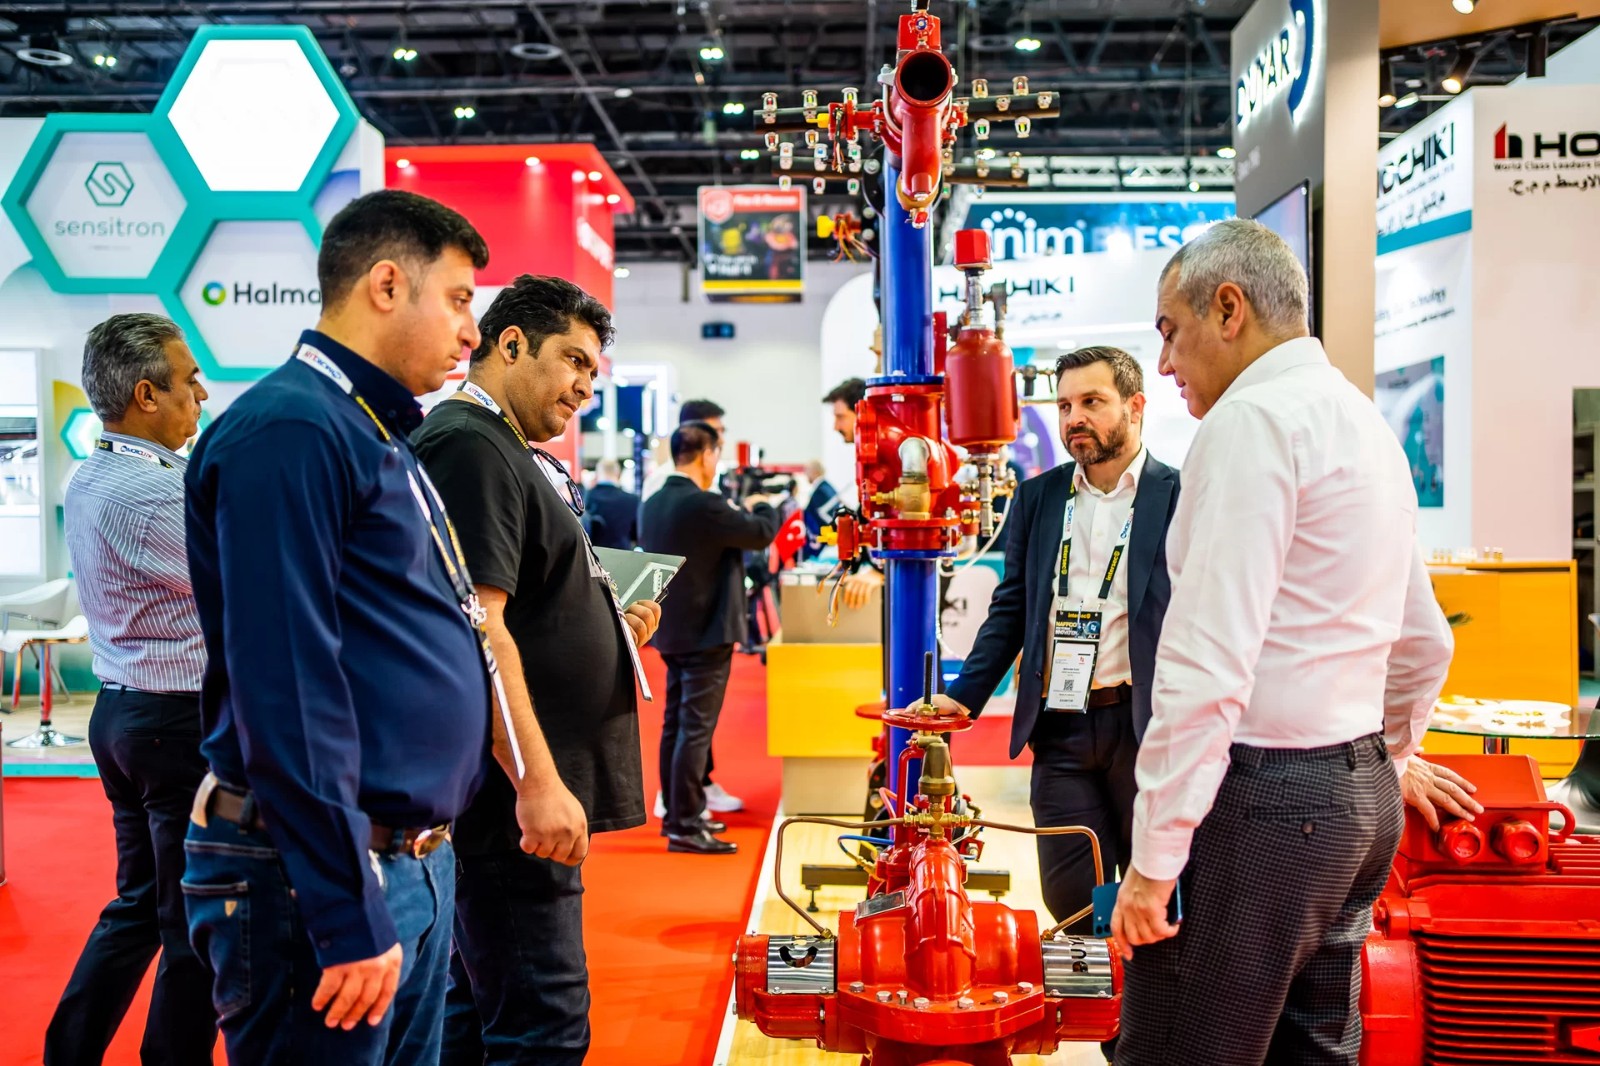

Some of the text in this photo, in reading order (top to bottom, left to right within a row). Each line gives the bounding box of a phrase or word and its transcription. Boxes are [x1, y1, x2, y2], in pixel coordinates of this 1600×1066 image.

[1236, 29, 1290, 126] DUYAR
[1494, 162, 1521, 170] World
[54, 217, 165, 237] sensitron
[981, 208, 1084, 259] inim
[234, 283, 321, 305] Halma
[939, 276, 1074, 302] HHIKI
[1105, 556, 1119, 581] intersec
